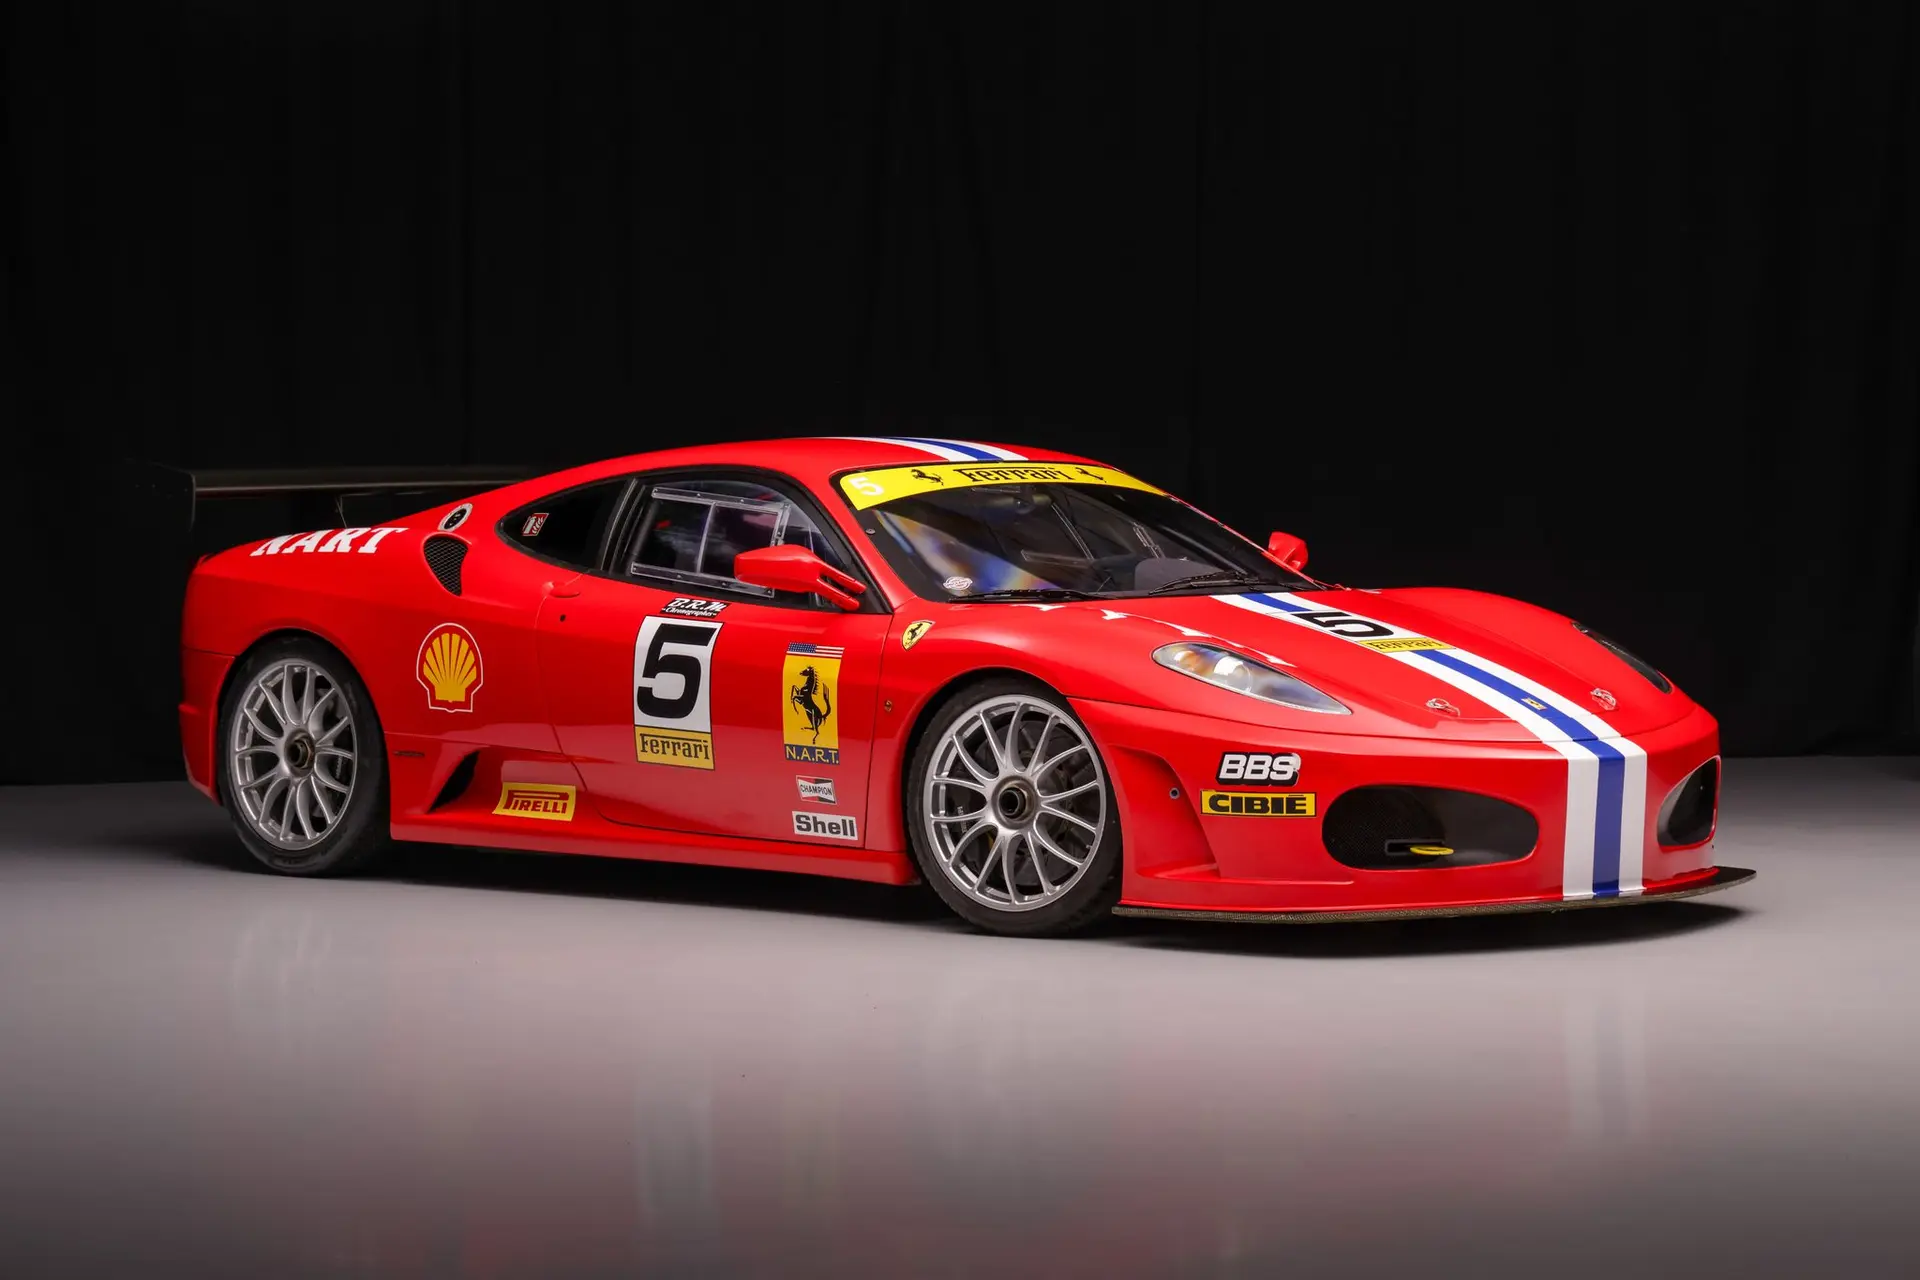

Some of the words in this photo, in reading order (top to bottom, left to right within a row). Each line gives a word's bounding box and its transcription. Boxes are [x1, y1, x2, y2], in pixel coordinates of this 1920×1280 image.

[849, 477, 884, 496] 5
[953, 467, 1076, 483] Ferrari
[249, 527, 410, 556] NART
[1291, 611, 1394, 638] 5
[1367, 640, 1444, 650] Ferrari
[636, 622, 718, 719] 5
[639, 733, 711, 760] Ferrari
[786, 746, 840, 764] N.A.R.T.
[1218, 754, 1298, 780] BBS
[800, 783, 833, 796] CHAMPION
[503, 790, 570, 814] PIRELLI
[795, 814, 856, 837] Shell
